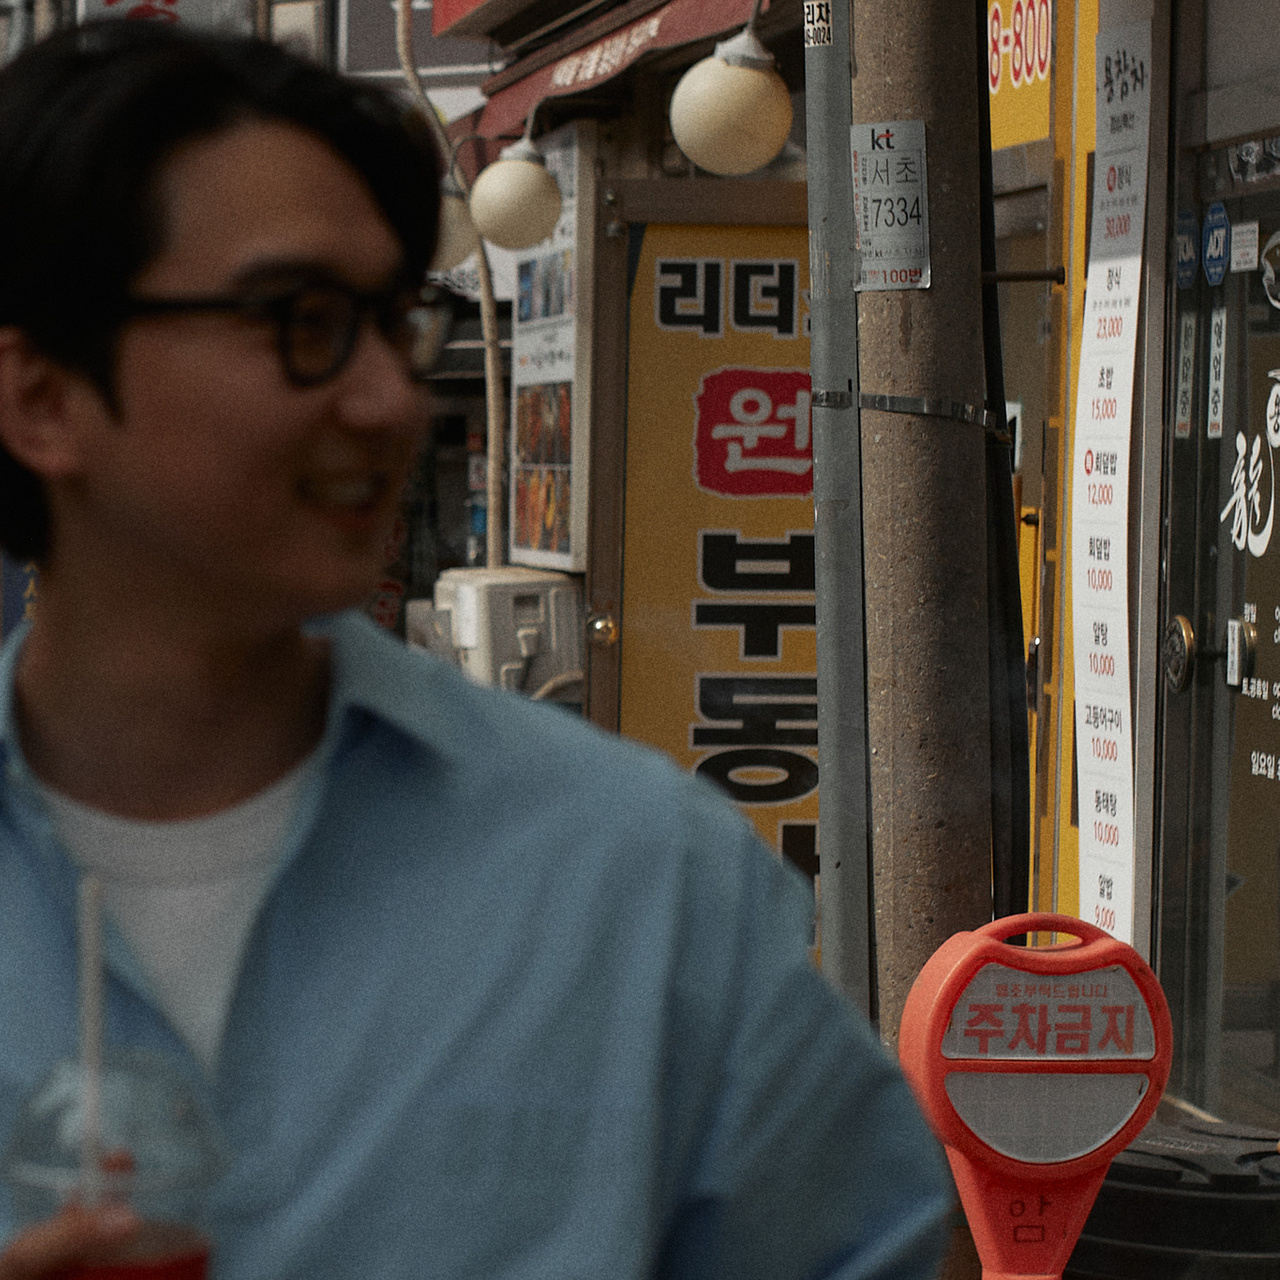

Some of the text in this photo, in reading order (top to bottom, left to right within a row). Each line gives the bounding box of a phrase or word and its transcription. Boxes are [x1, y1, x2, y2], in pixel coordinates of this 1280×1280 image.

[871, 128, 895, 151] kt
[872, 157, 918, 187] 서초
[871, 196, 922, 229] 7334
[1206, 227, 1227, 260] ADT
[658, 261, 814, 336] 리더
[1091, 398, 1118, 421] 15,000
[1087, 484, 1113, 506] 12,000
[1086, 569, 1113, 591] 10,000
[1088, 652, 1115, 677] 10,000
[1084, 703, 1123, 733] 고등어구이
[1091, 737, 1118, 762] 10,000
[1093, 820, 1120, 847] 10,000
[1094, 904, 1116, 931] 9,000
[964, 1002, 1136, 1056] 주차금지
